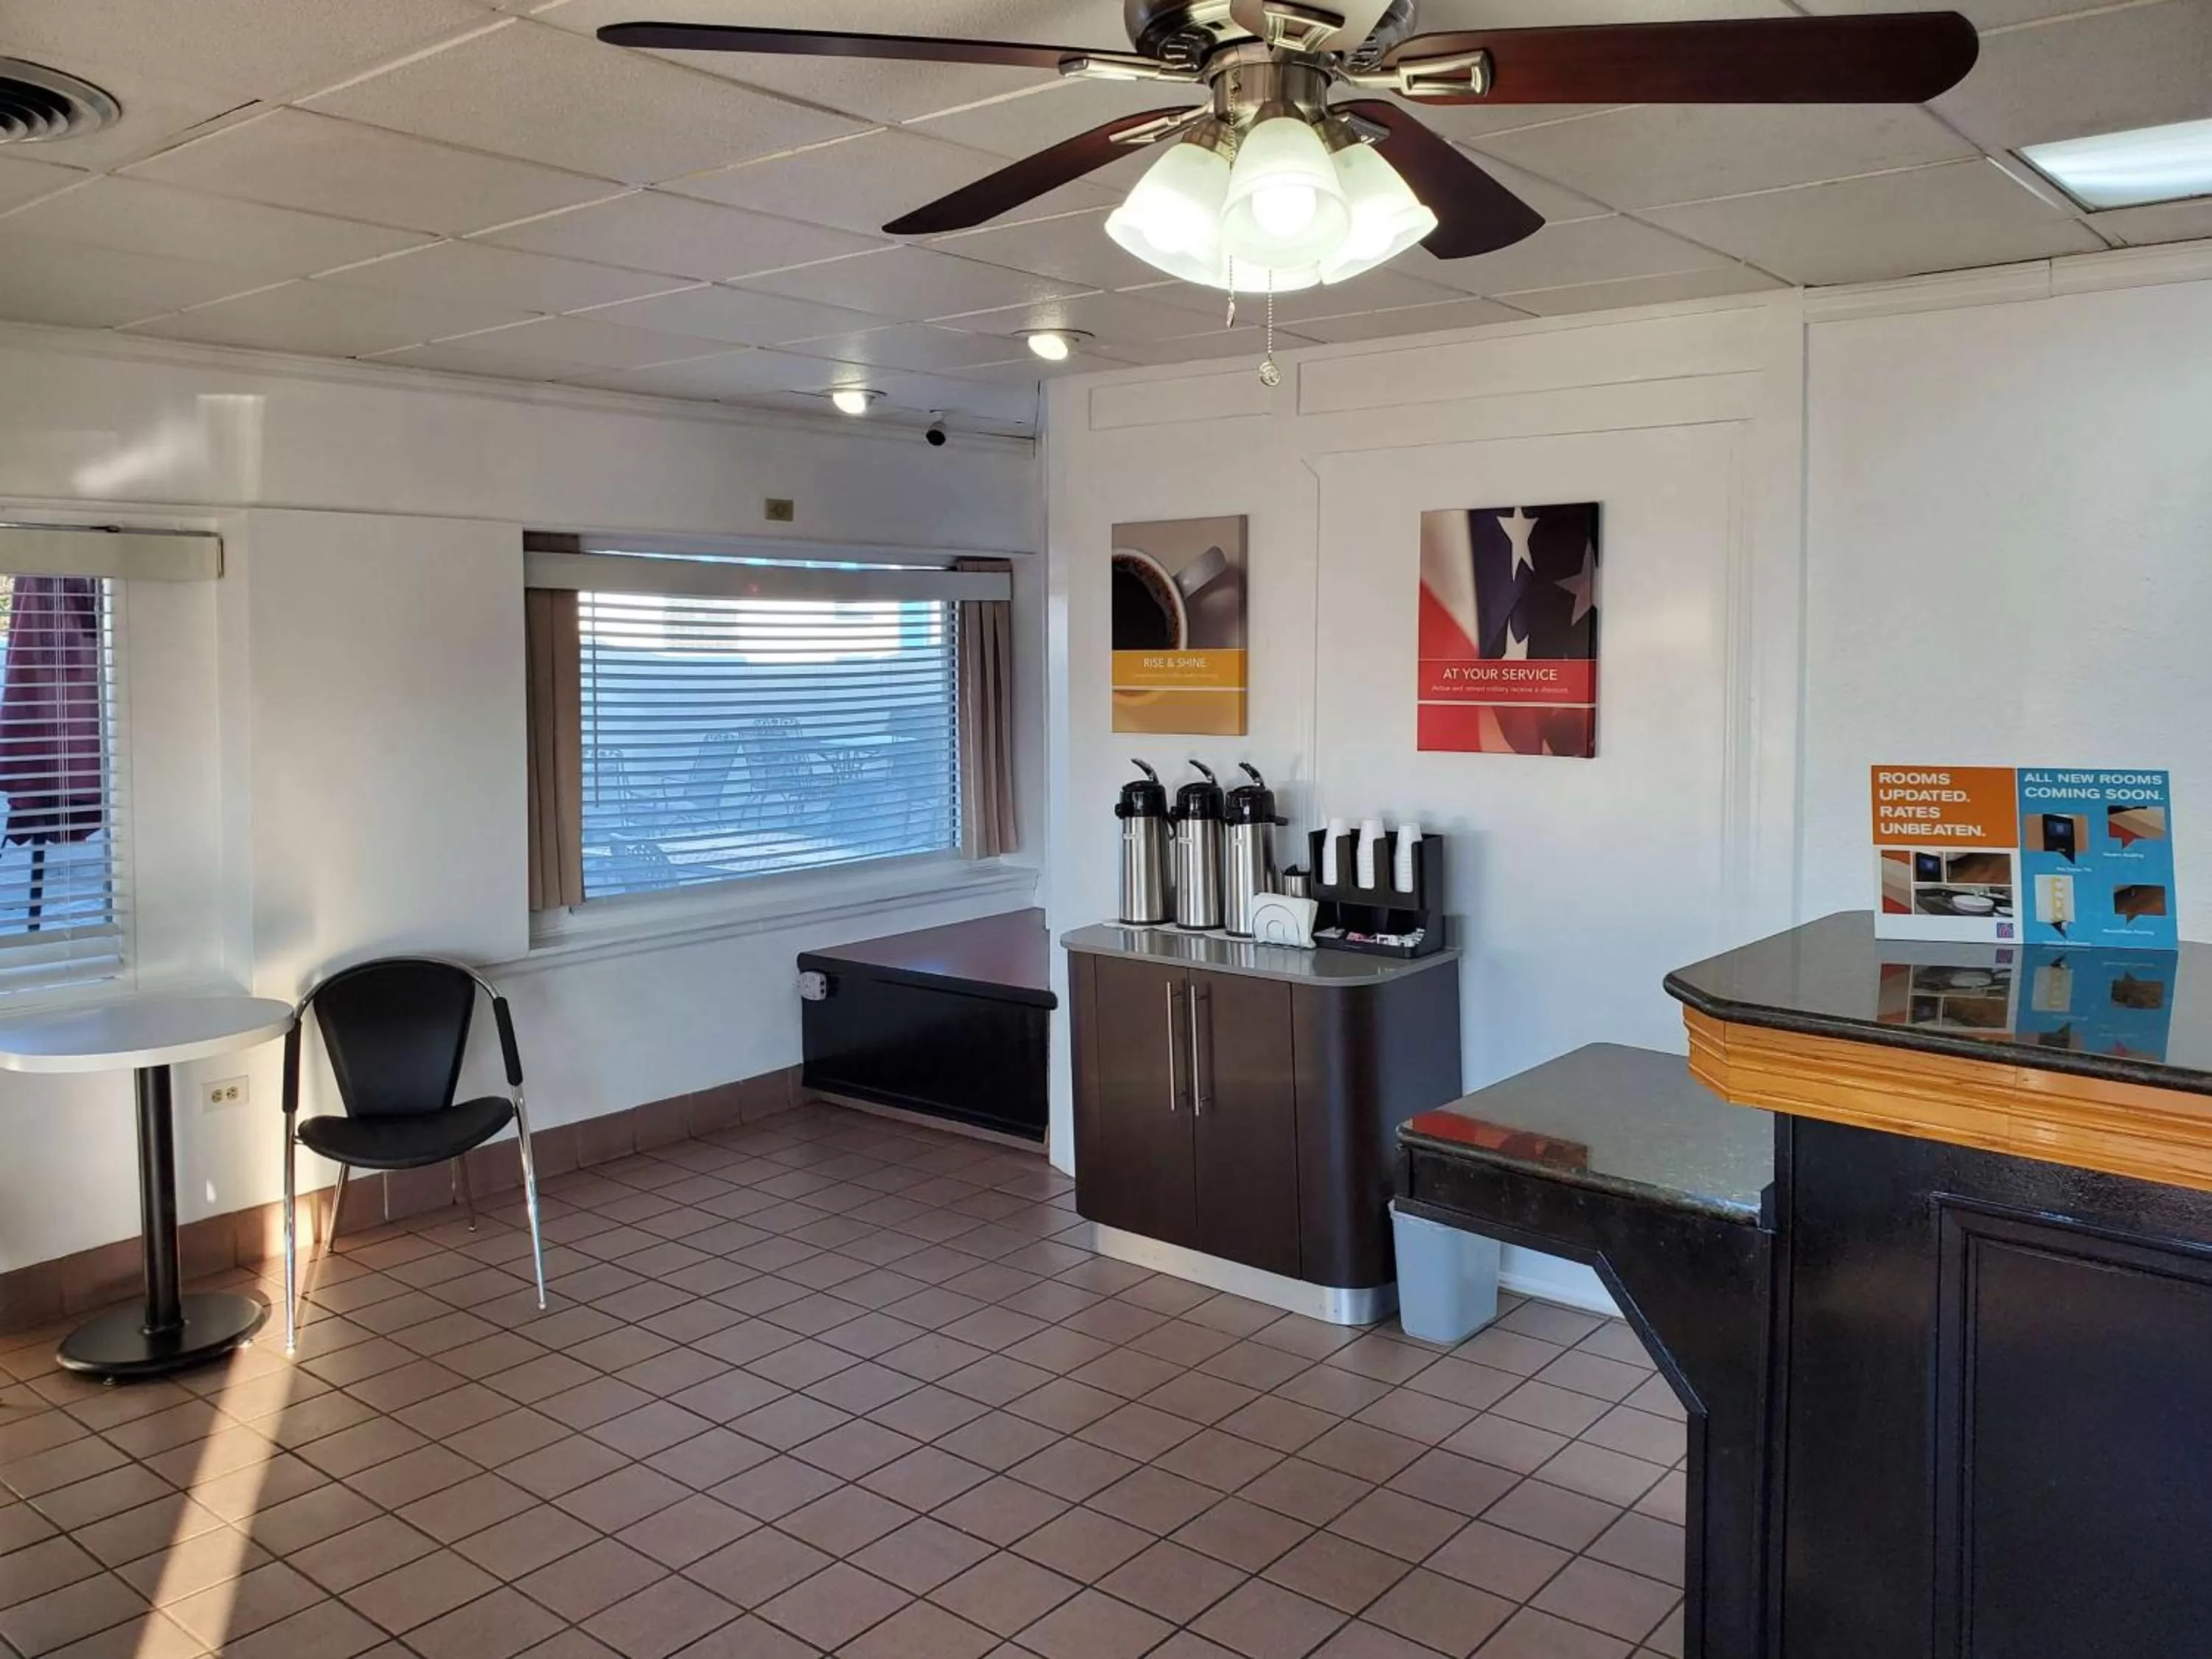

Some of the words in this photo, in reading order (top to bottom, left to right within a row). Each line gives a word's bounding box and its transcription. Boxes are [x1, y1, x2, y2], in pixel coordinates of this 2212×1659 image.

[1144, 657, 1164, 667] RISE
[1177, 657, 1207, 668] SHINE
[1443, 668, 1459, 679] AT
[1462, 668, 1498, 680] YOUR
[1502, 669, 1558, 681] SERVICE
[1879, 772, 1951, 785] ROOMS
[2024, 773, 2053, 783] ALL
[2058, 773, 2094, 784] NEW
[2099, 774, 2163, 785] ROOMS
[1879, 788, 1971, 802] UPDATED.
[2025, 787, 2101, 799] COMING
[2105, 788, 2165, 801] SOON.
[1880, 806, 1941, 818] RATES
[1881, 822, 1986, 837] UNBEATEN.
